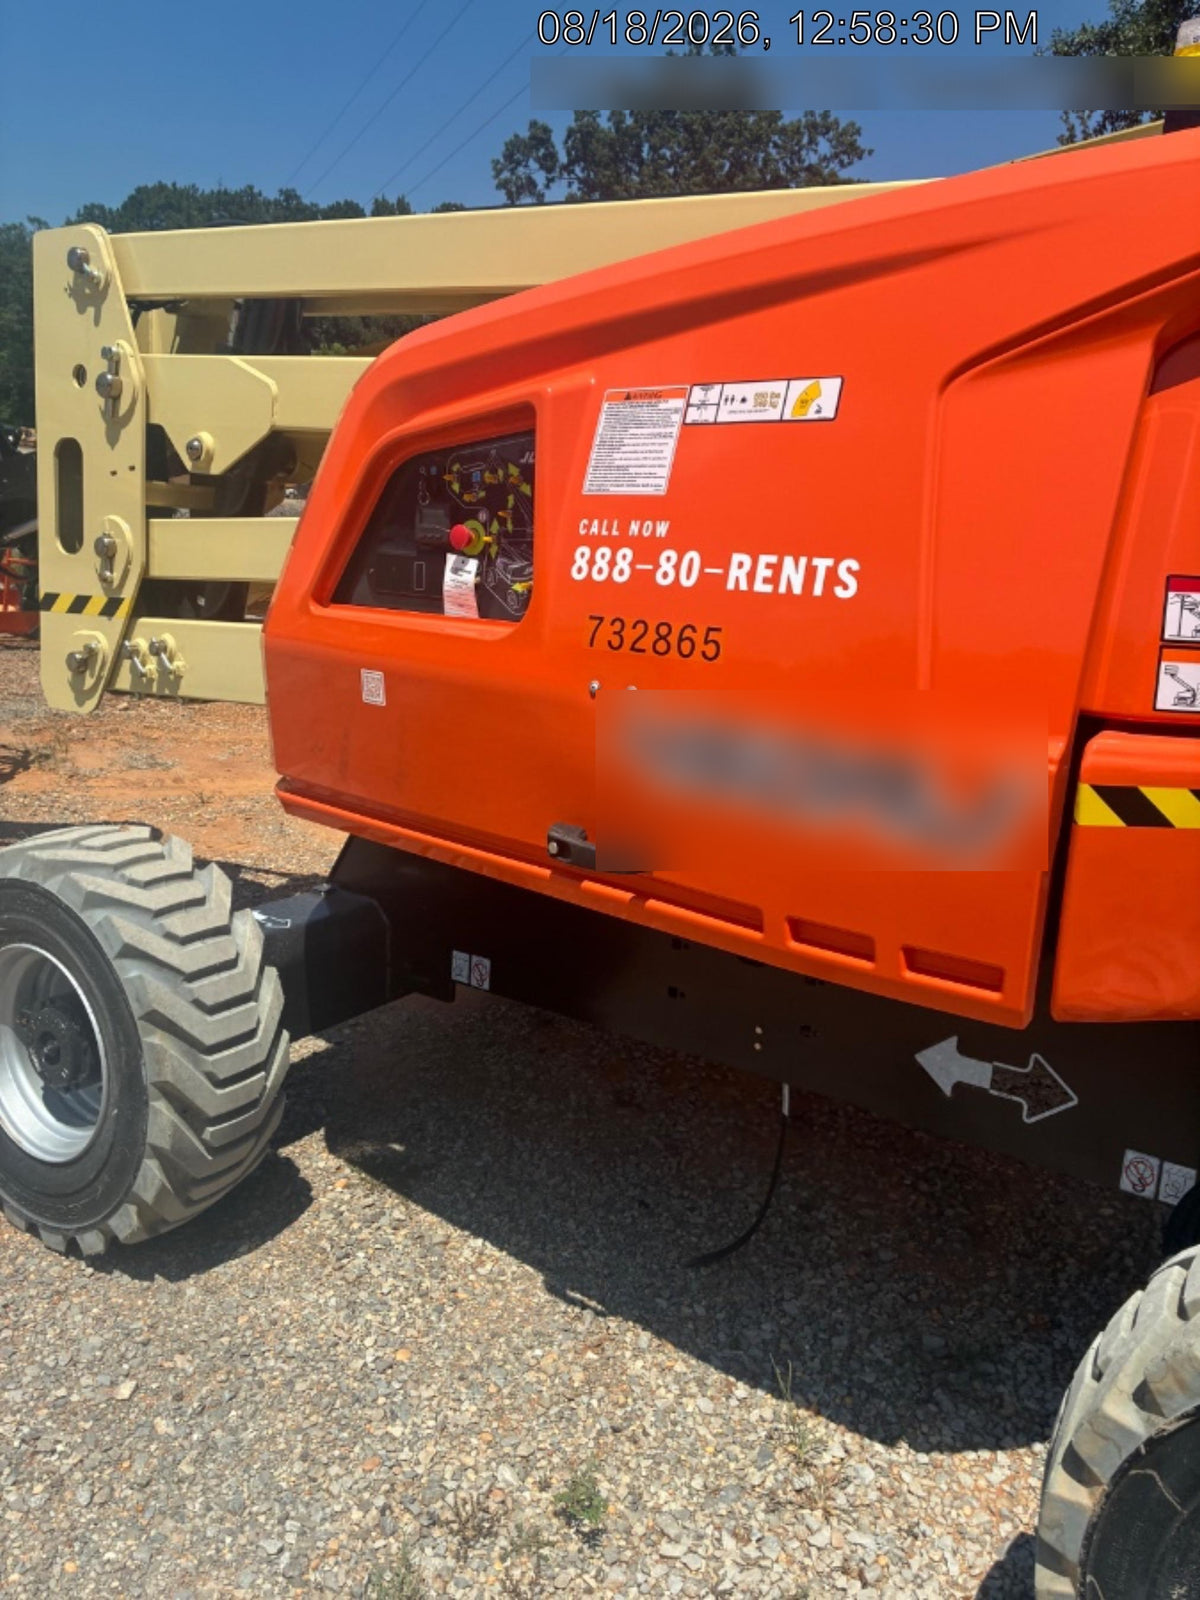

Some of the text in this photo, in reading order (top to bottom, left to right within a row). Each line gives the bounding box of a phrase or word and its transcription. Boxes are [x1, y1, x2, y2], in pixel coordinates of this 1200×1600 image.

[578, 518, 671, 538] CALL NOW
[570, 545, 861, 600] 888-80-RENTS
[587, 614, 723, 663] 732865
